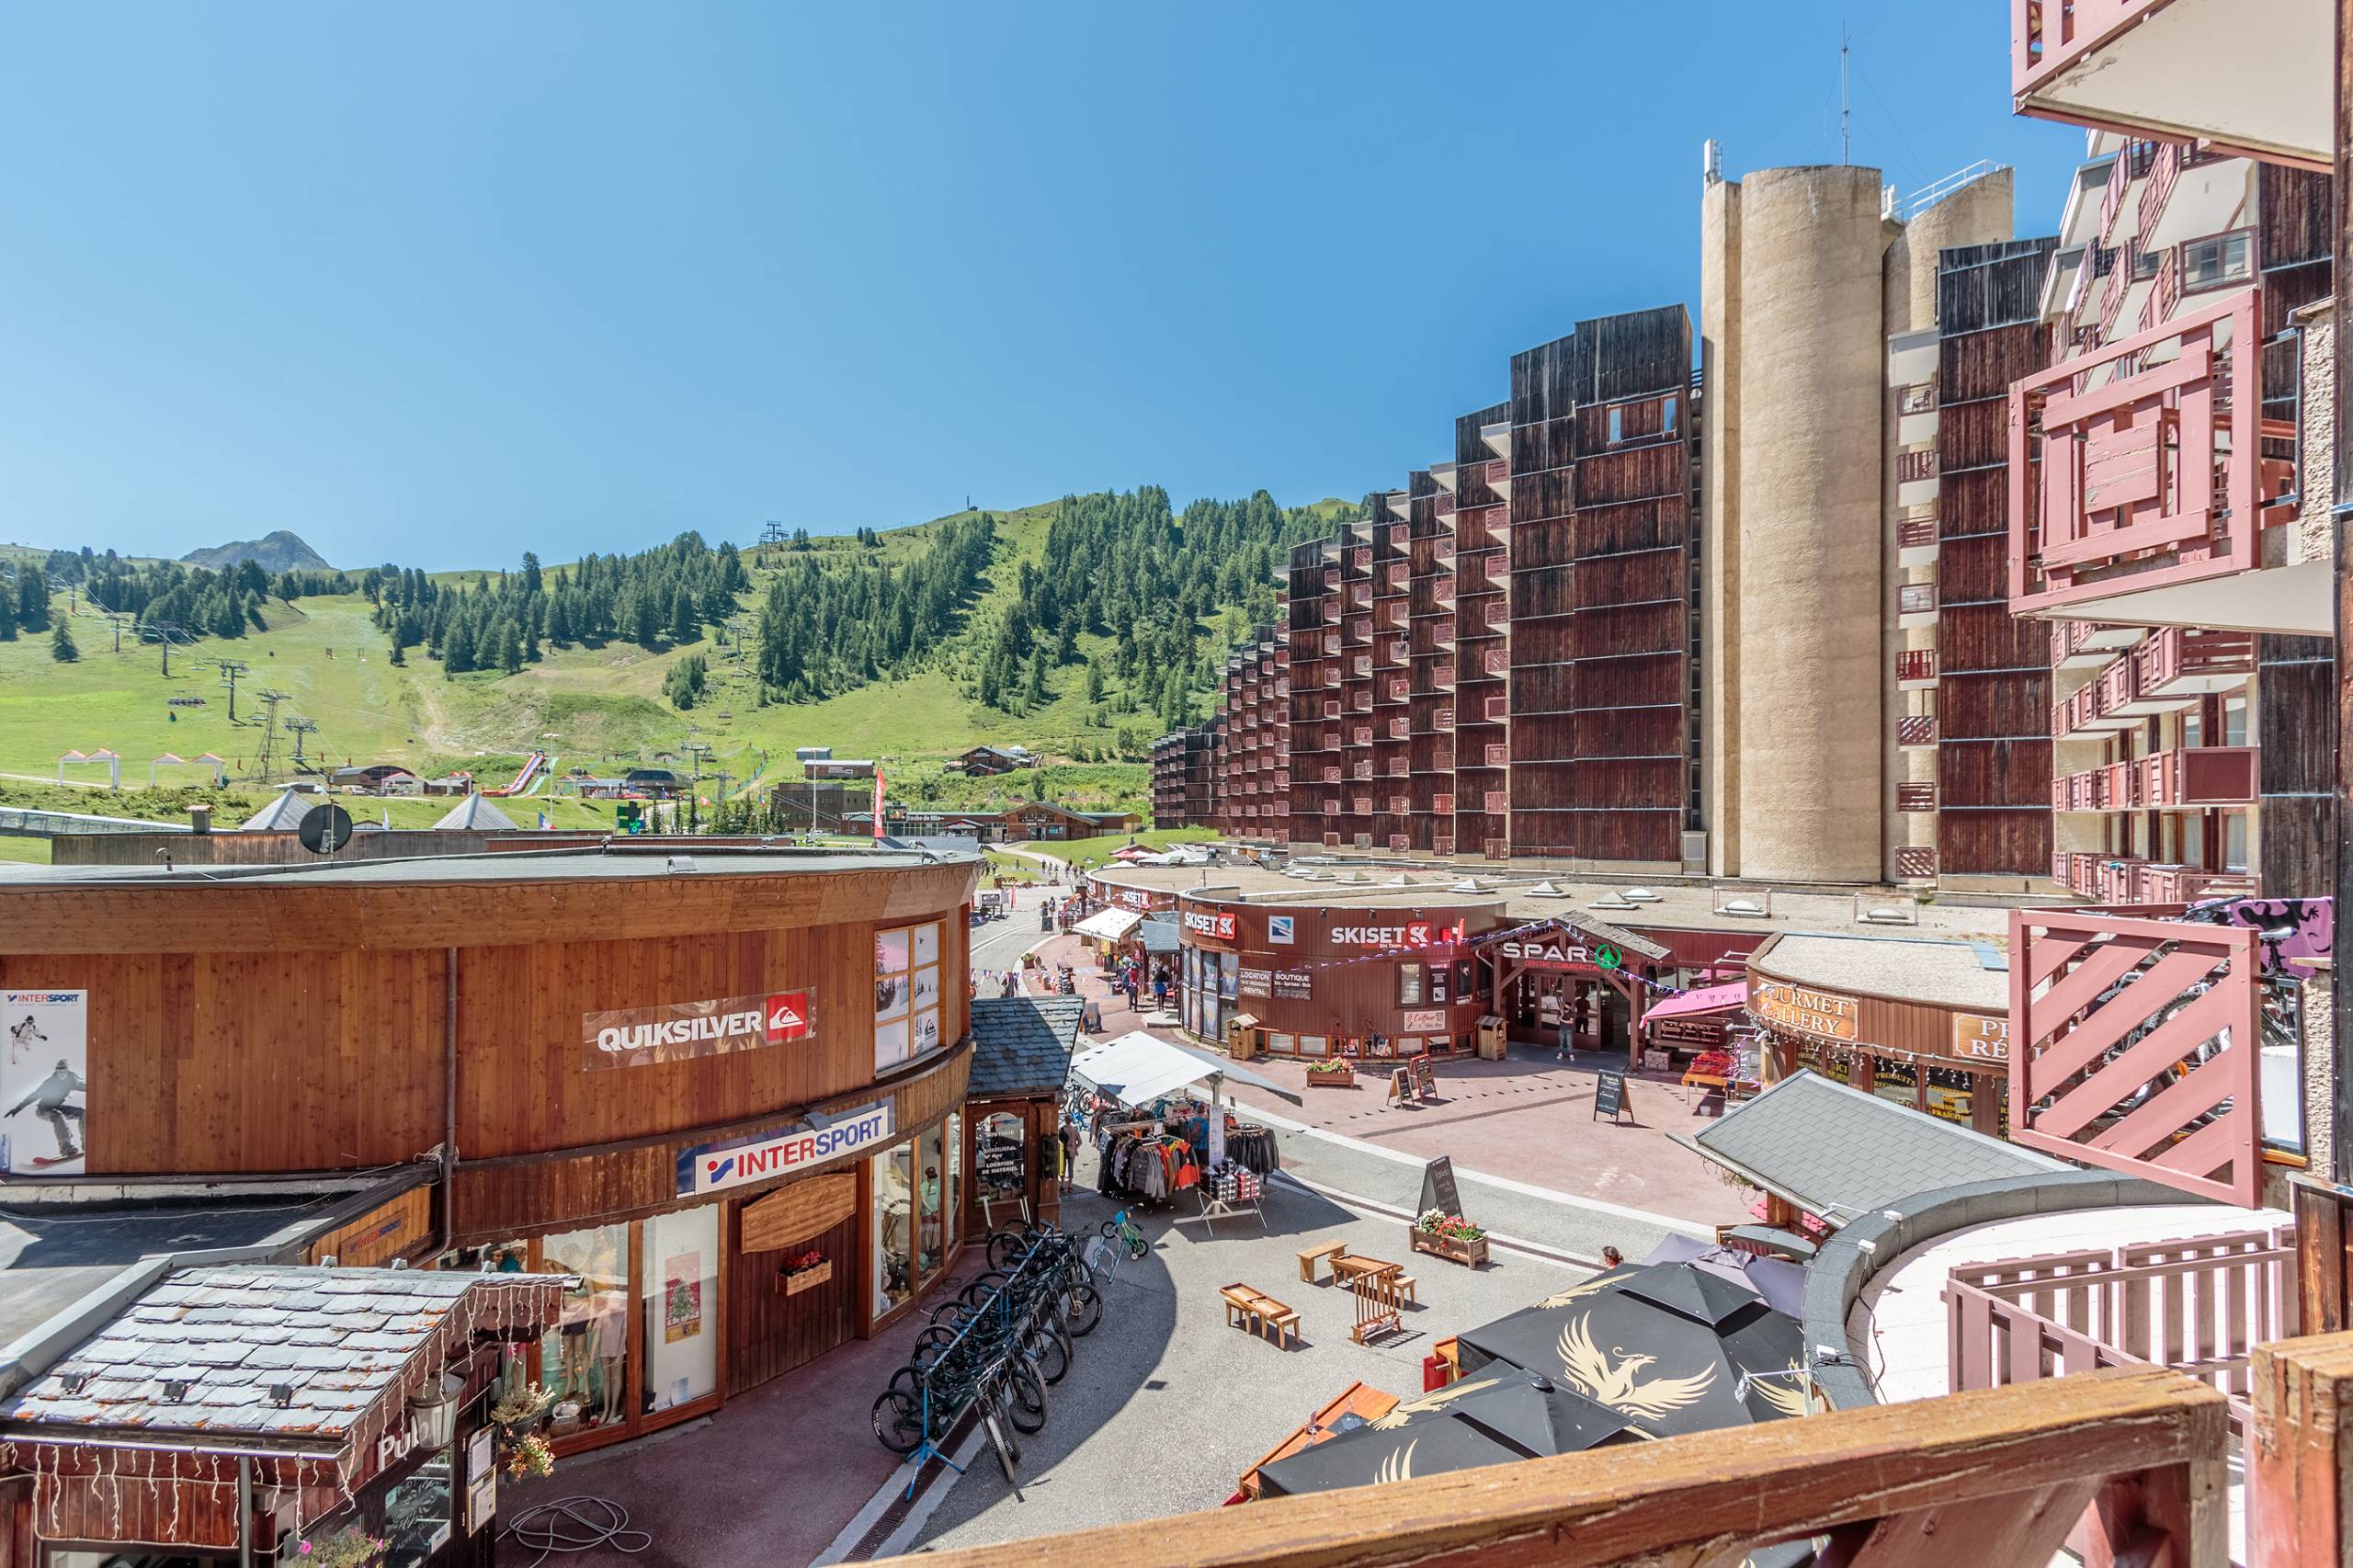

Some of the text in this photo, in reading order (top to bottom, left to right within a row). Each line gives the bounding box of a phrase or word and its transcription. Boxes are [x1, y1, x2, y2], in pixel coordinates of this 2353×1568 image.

[1185, 912, 1219, 932] SKISET
[1331, 926, 1405, 944] SKISET
[1503, 942, 1588, 962] SPAR
[1553, 961, 1601, 971] COMMERCIAL
[1241, 971, 1270, 981] LOCATION
[1275, 973, 1310, 982] BOUTIQUE
[18, 994, 79, 1003] INTERSPORT
[1244, 986, 1267, 995] RENTAL
[1766, 986, 1849, 1017] OURMET
[597, 1010, 763, 1052] QUIKSILVER
[1875, 1072, 1916, 1087] PRODUITS
[738, 1115, 882, 1177] INTERSPORT
[986, 1160, 1014, 1168] LOCATION
[358, 1220, 401, 1249] INTERSPORT
